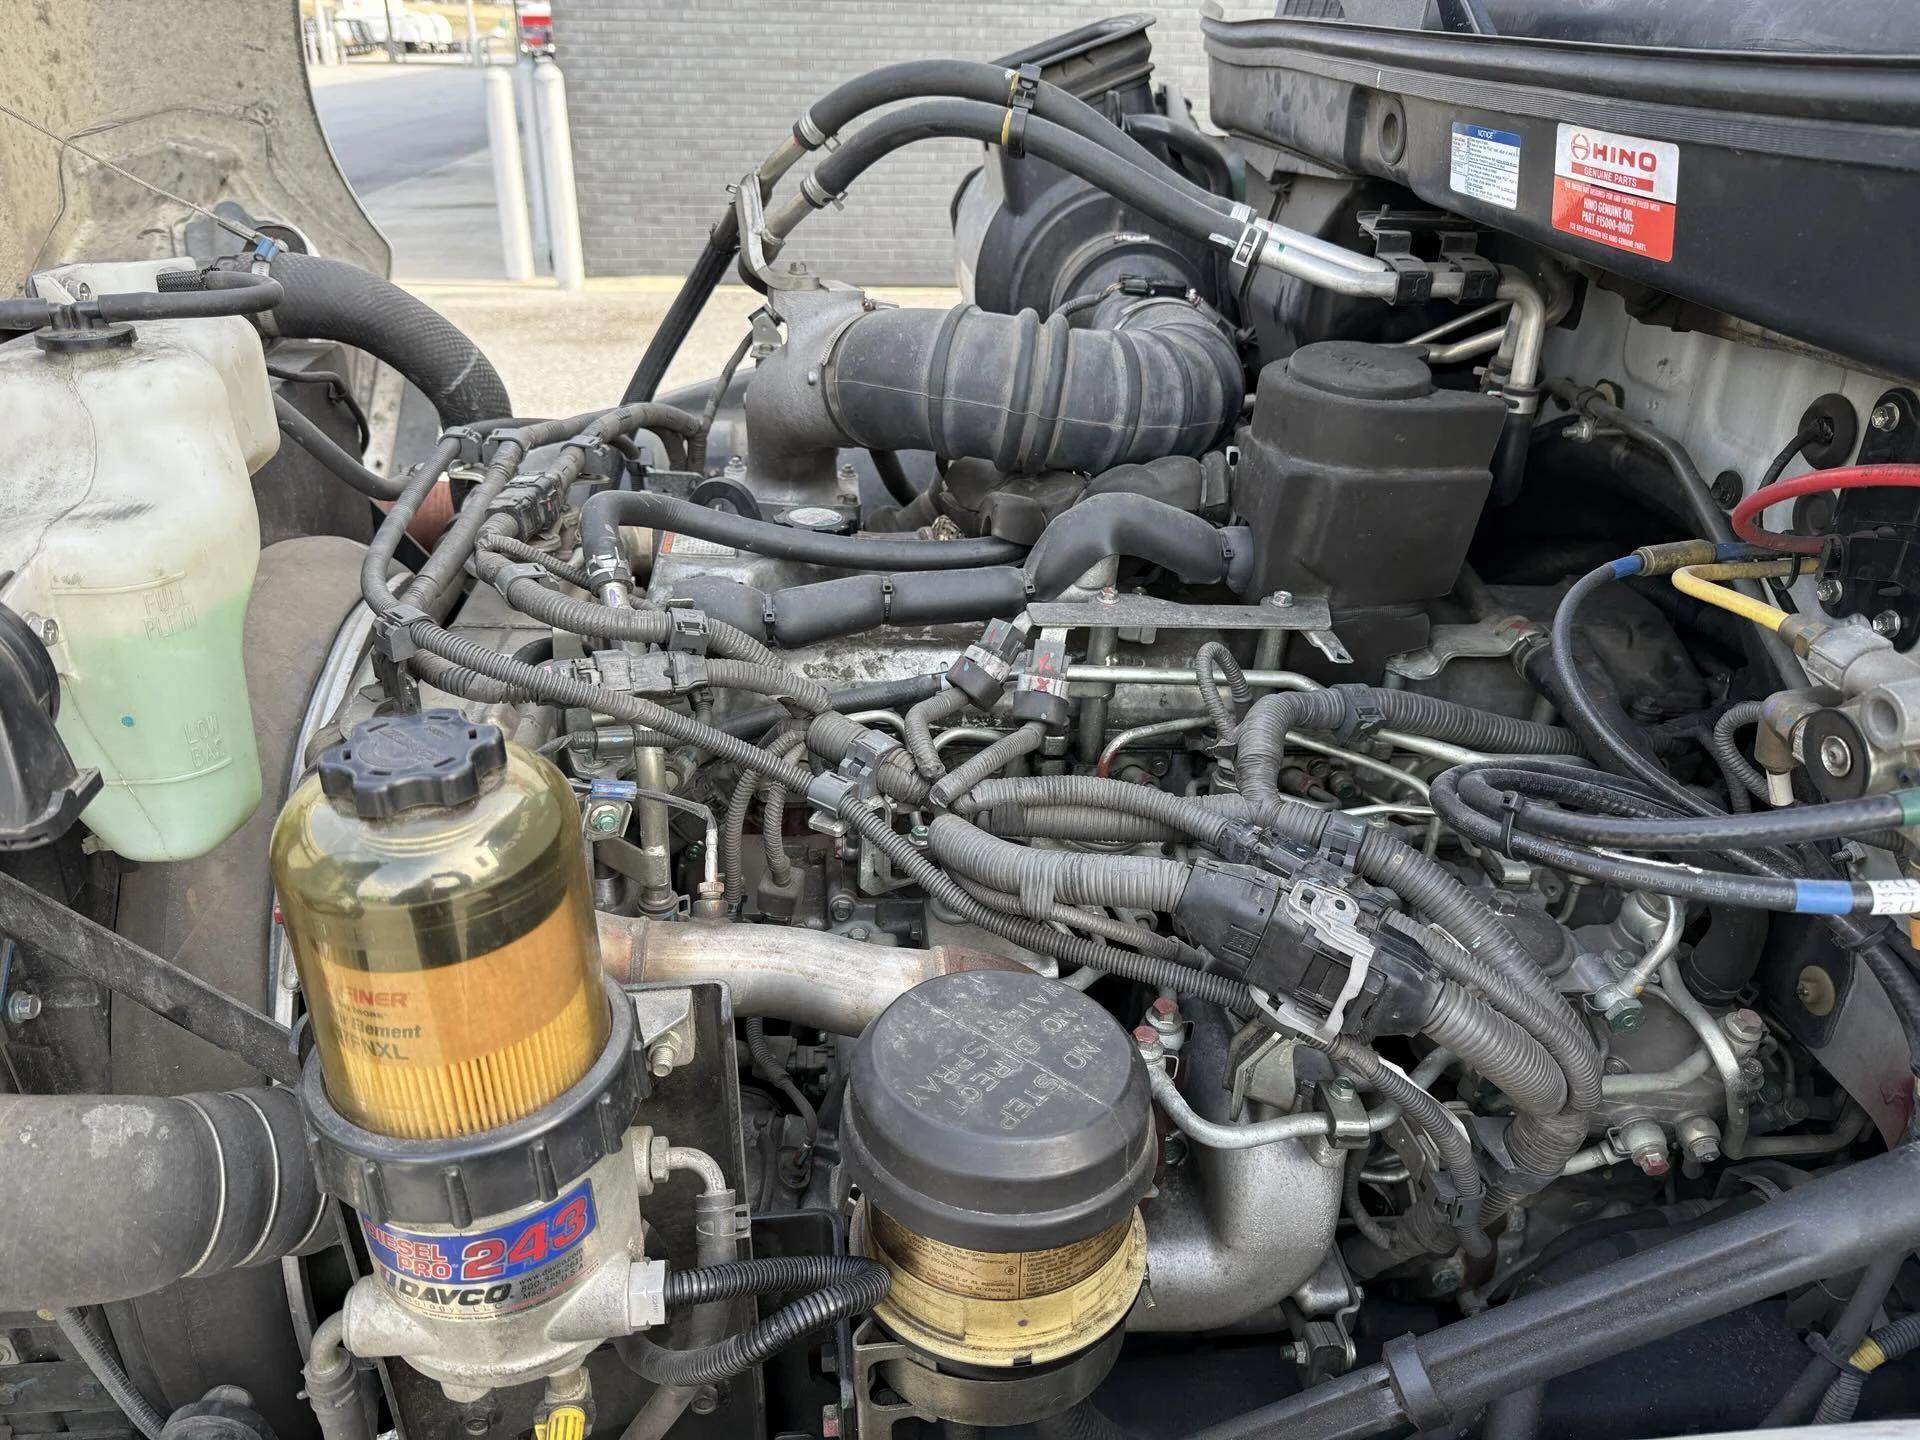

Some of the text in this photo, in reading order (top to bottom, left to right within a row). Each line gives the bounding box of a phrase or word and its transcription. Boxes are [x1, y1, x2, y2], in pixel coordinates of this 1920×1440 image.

[1593, 142, 1657, 173] HINO
[1584, 167, 1638, 188] GENUINE PARTS
[1582, 210, 1595, 225] PART
[1584, 197, 1633, 221] HINO GENUINE OIL
[1634, 874, 1676, 890] MEXICO
[1681, 882, 1693, 892] IN
[1701, 886, 1729, 898] MADE
[906, 981, 1064, 1108] WATER SPRAY
[943, 1007, 1079, 1117] NO DIRECT
[1000, 1040, 1102, 1130] NO STEP
[362, 1218, 448, 1263] DIESEL
[461, 1196, 588, 1281] 243
[396, 1254, 452, 1280] PRO
[519, 1247, 584, 1286] www.davco.com
[399, 1279, 513, 1306] DAVCO
[522, 1285, 547, 1299] Made
